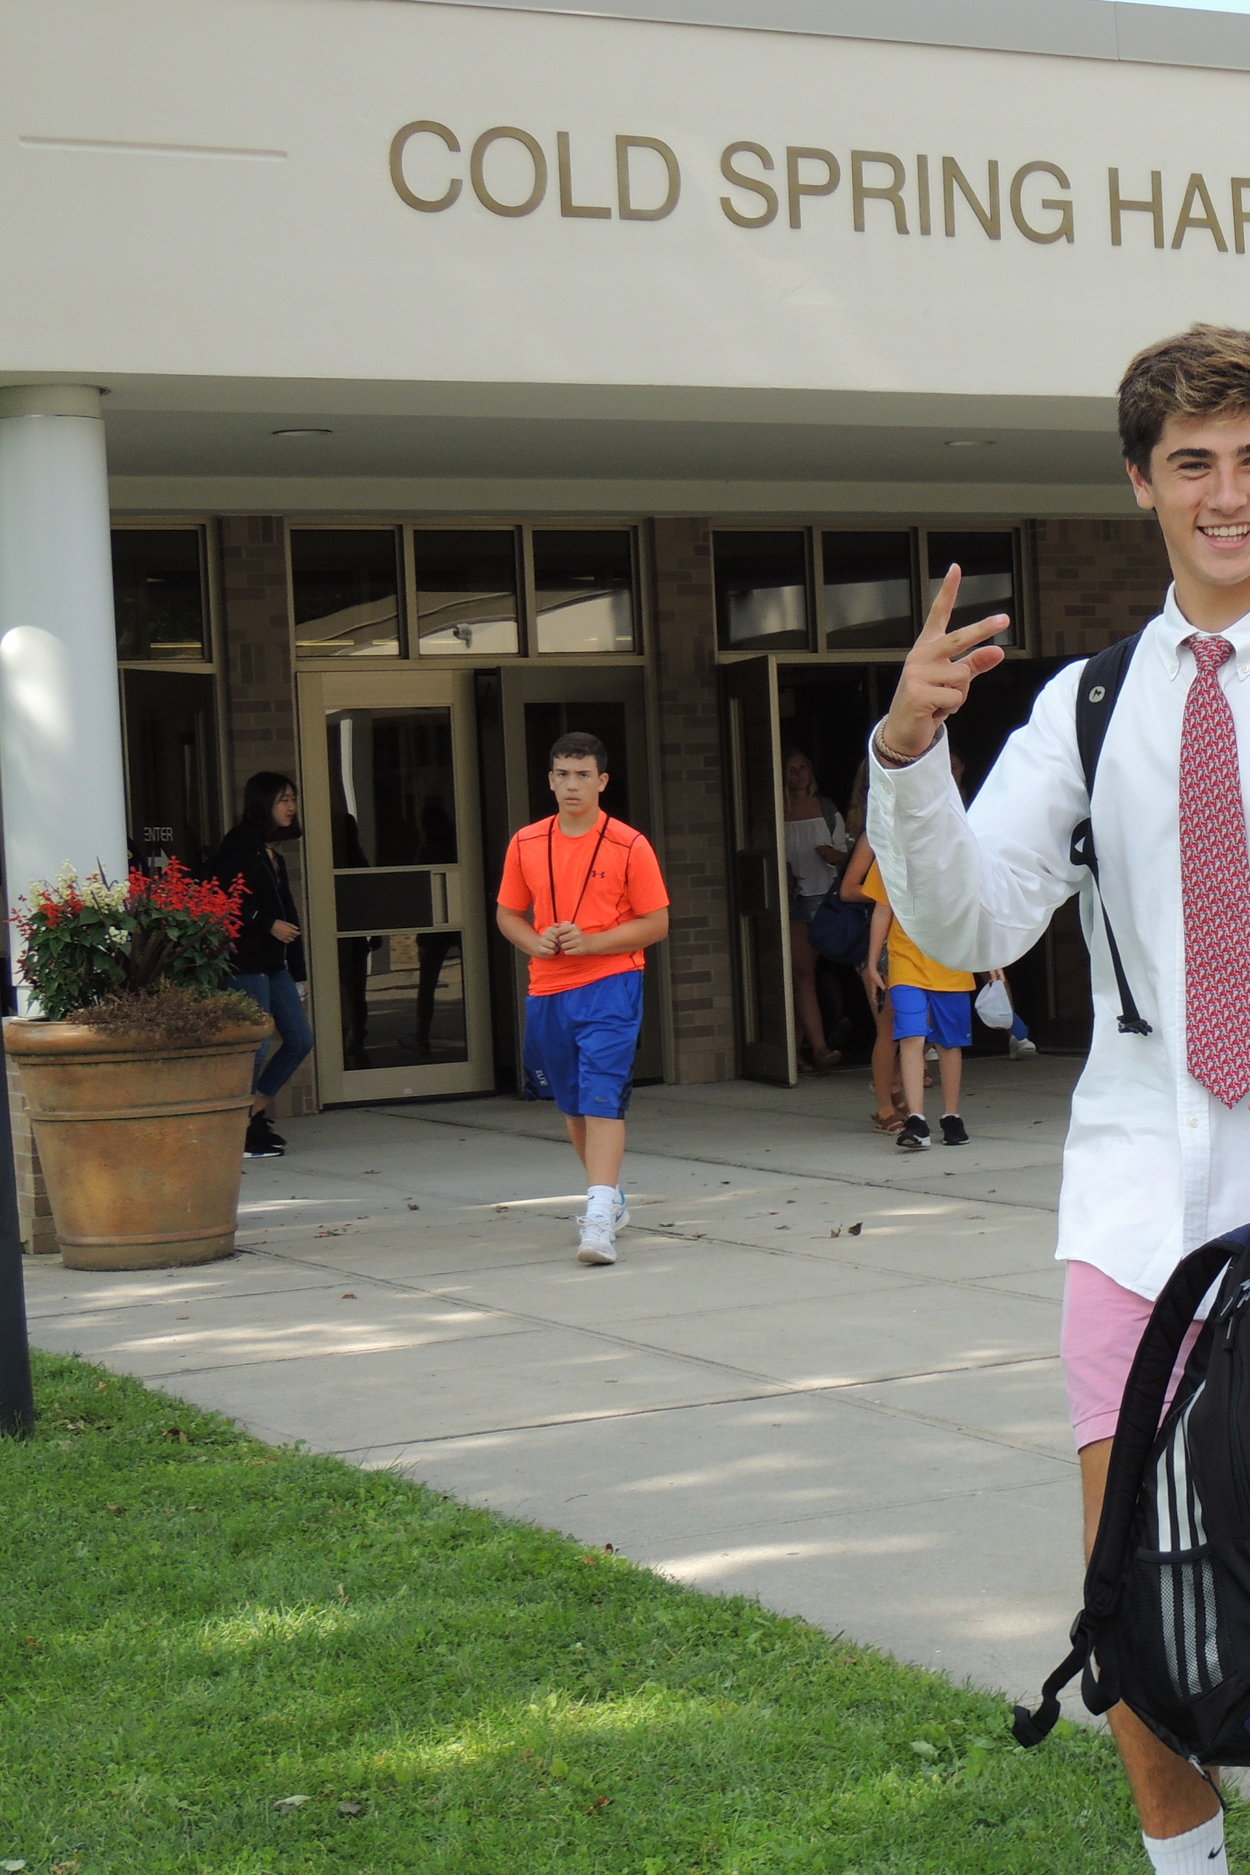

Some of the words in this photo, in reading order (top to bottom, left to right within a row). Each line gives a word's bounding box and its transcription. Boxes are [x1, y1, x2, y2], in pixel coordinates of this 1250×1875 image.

[388, 119, 682, 223] COLD
[719, 140, 1075, 246] SPRING
[143, 826, 174, 842] ENTER
